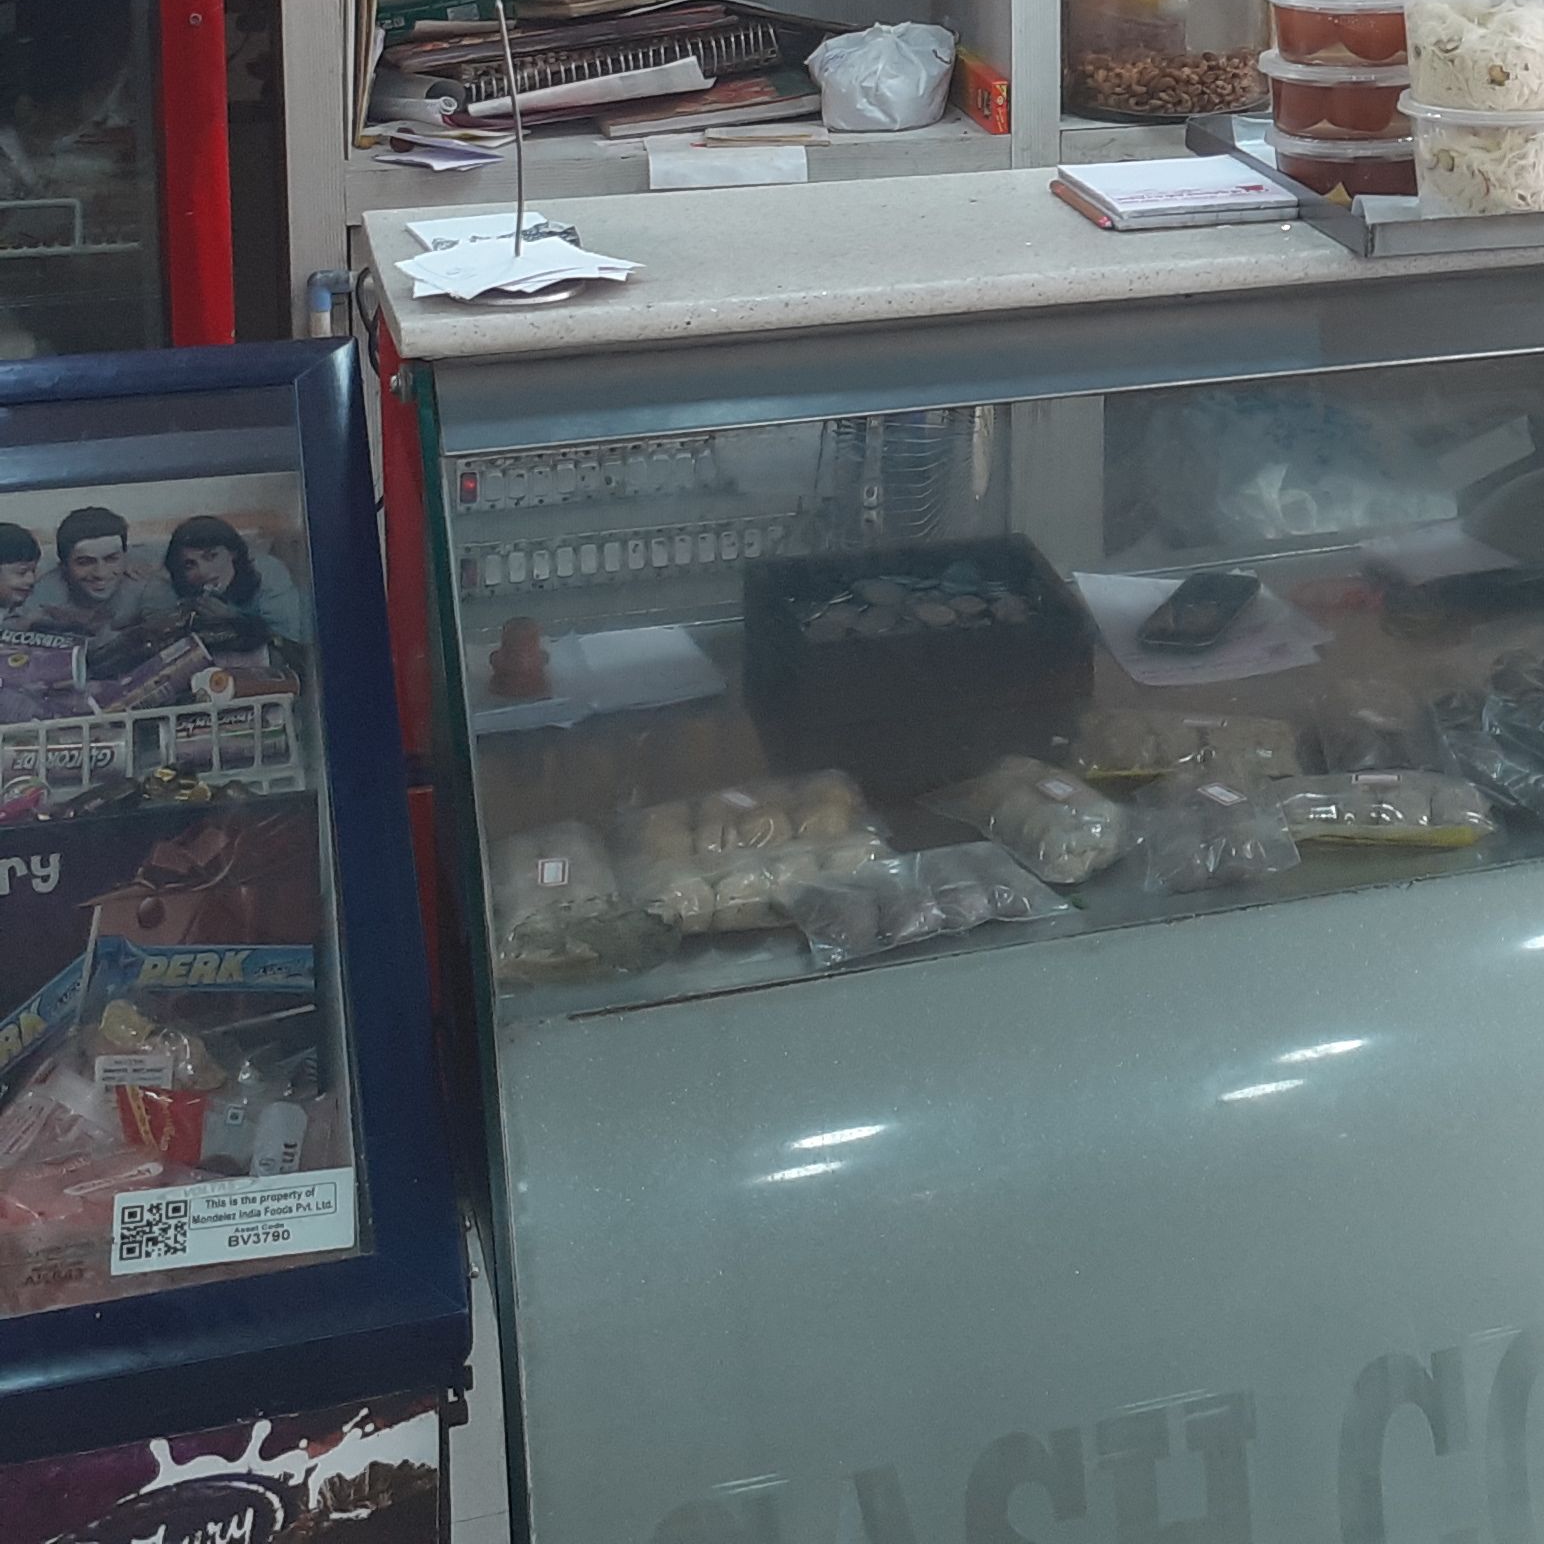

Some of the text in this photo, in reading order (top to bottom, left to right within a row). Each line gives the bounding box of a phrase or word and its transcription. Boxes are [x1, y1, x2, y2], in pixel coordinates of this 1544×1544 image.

[139, 949, 251, 986] PERK
[205, 1186, 316, 1210] This is the property of
[192, 1210, 237, 1225] Mondelez
[239, 1208, 262, 1219] India
[264, 1205, 293, 1216] Foods
[228, 1228, 291, 1248] BV3790
